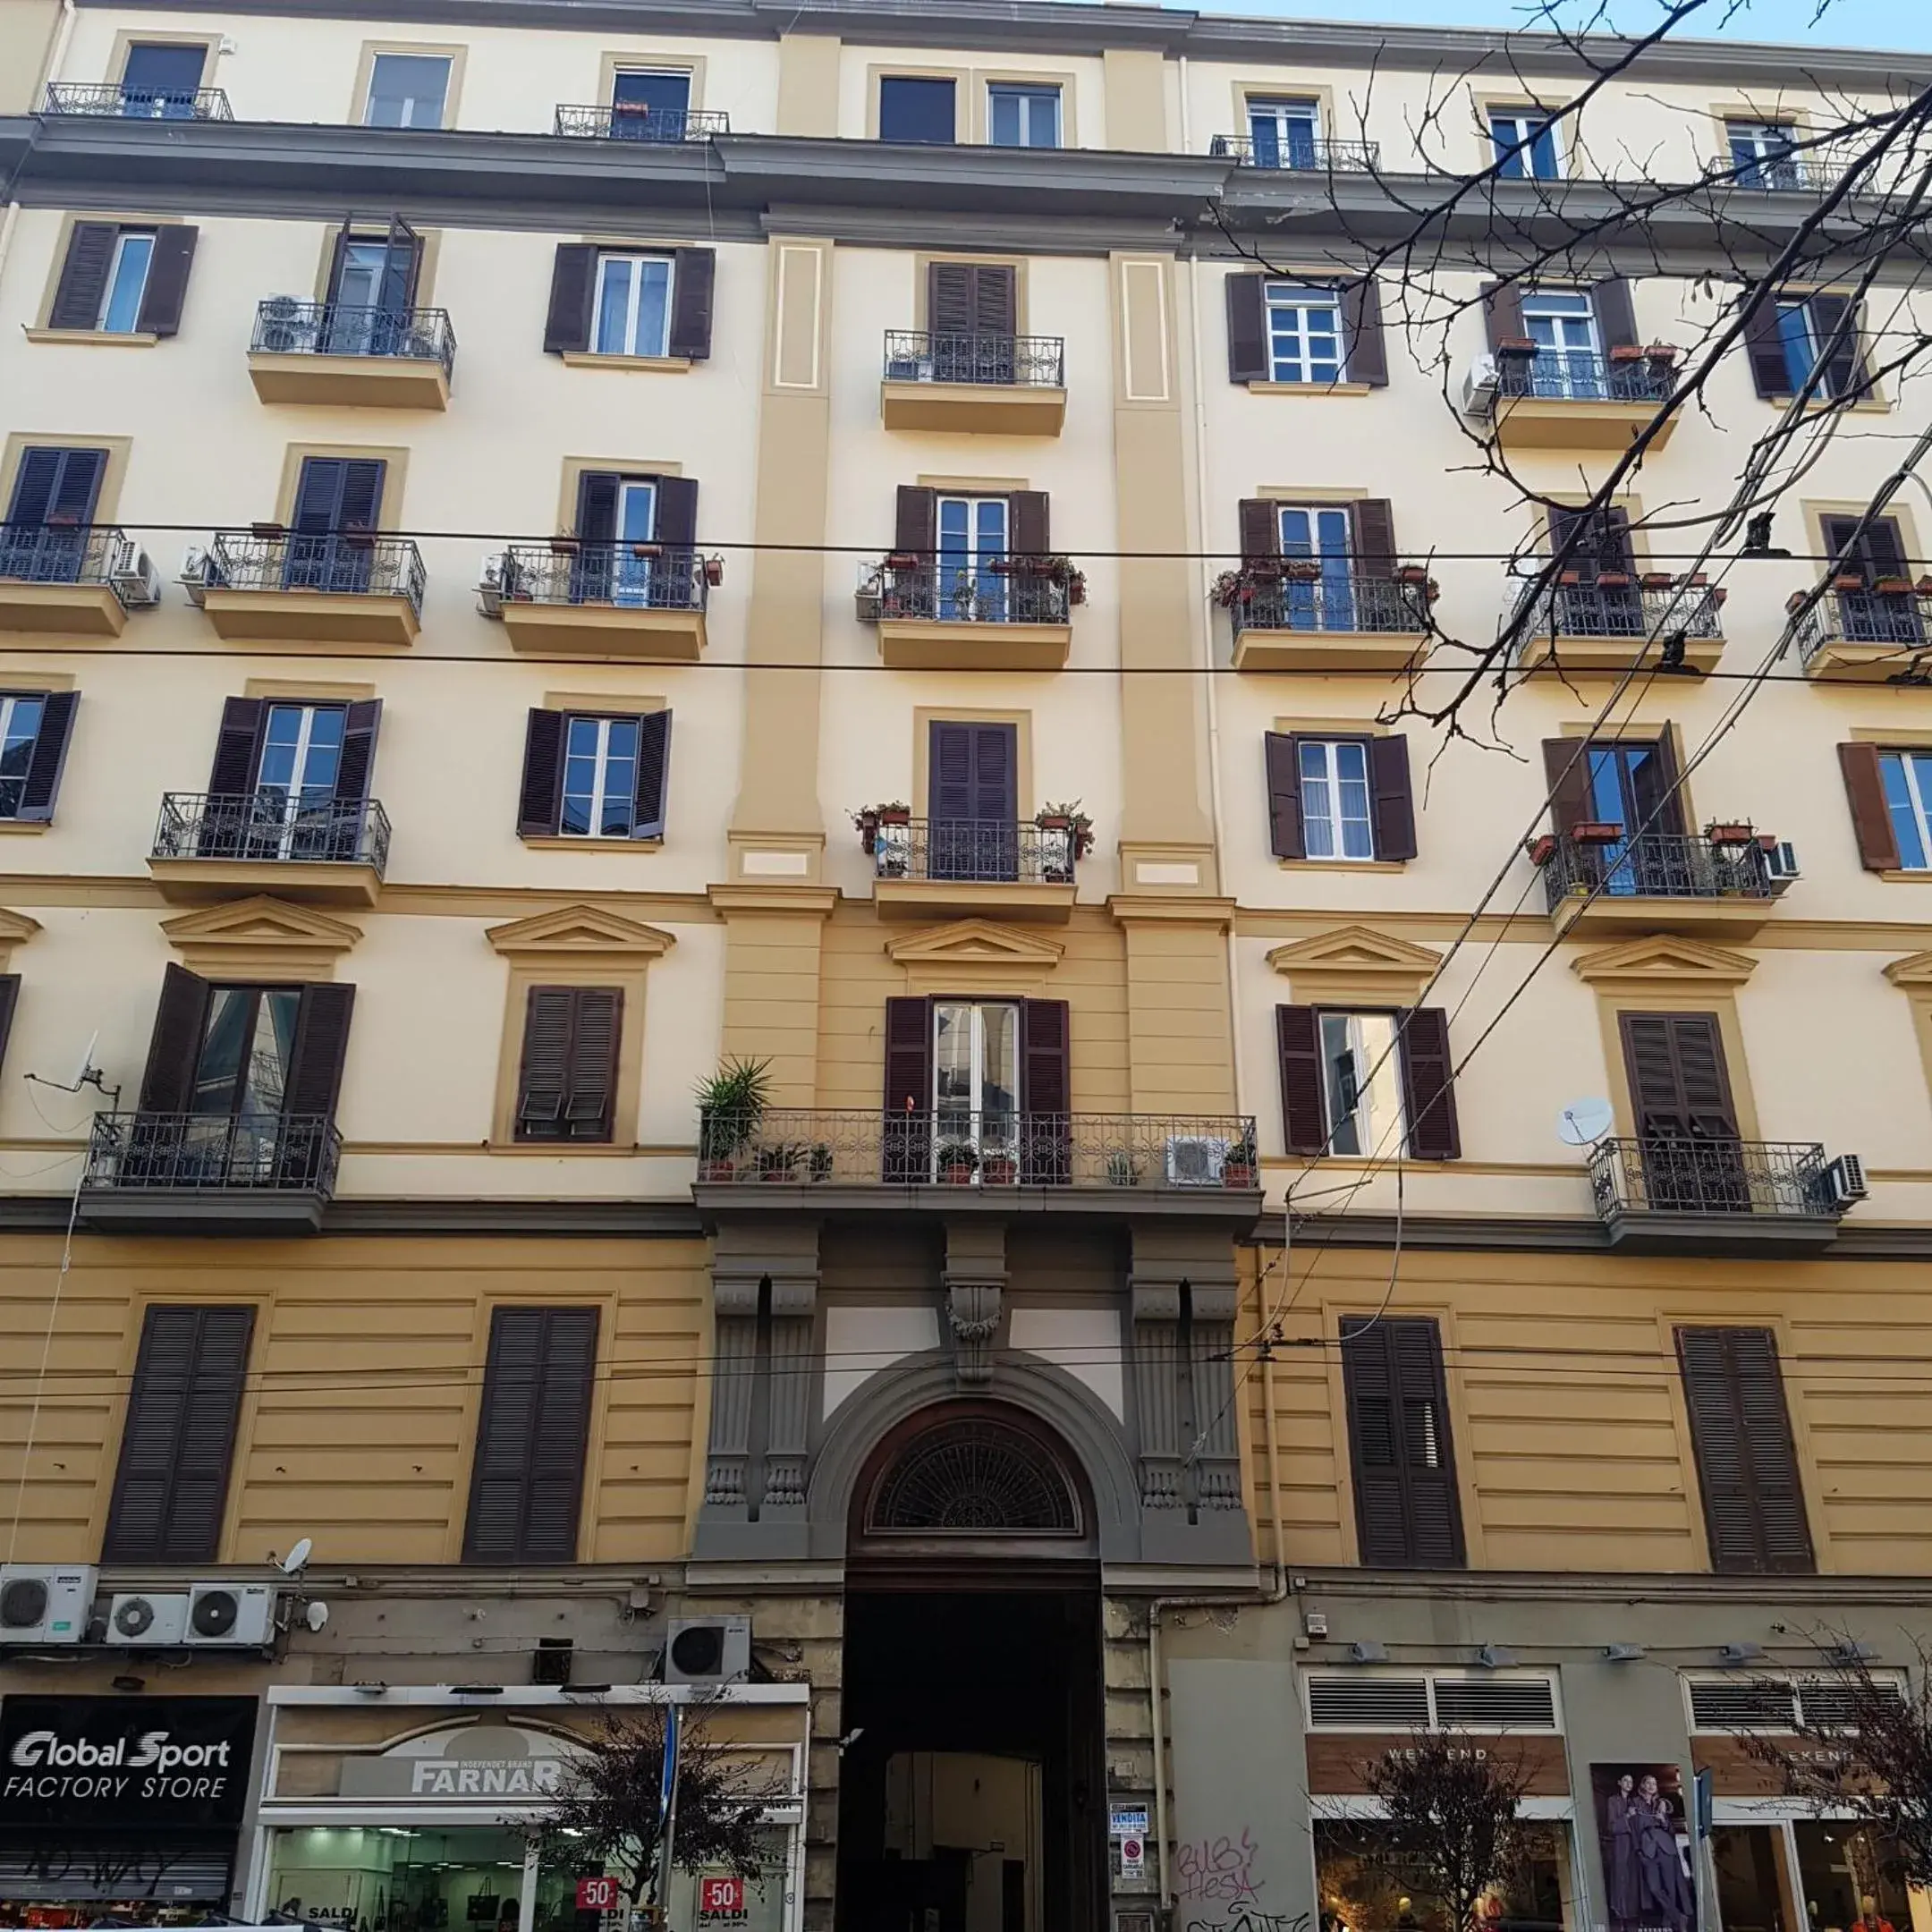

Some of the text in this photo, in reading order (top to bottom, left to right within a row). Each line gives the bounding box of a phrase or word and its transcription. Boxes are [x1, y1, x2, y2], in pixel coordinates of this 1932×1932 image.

[11, 1731, 231, 1773] Global Sport
[4, 1776, 226, 1798] FACTORY STORE
[308, 1907, 359, 1919] SALDI
[699, 1909, 748, 1920] SALDI
